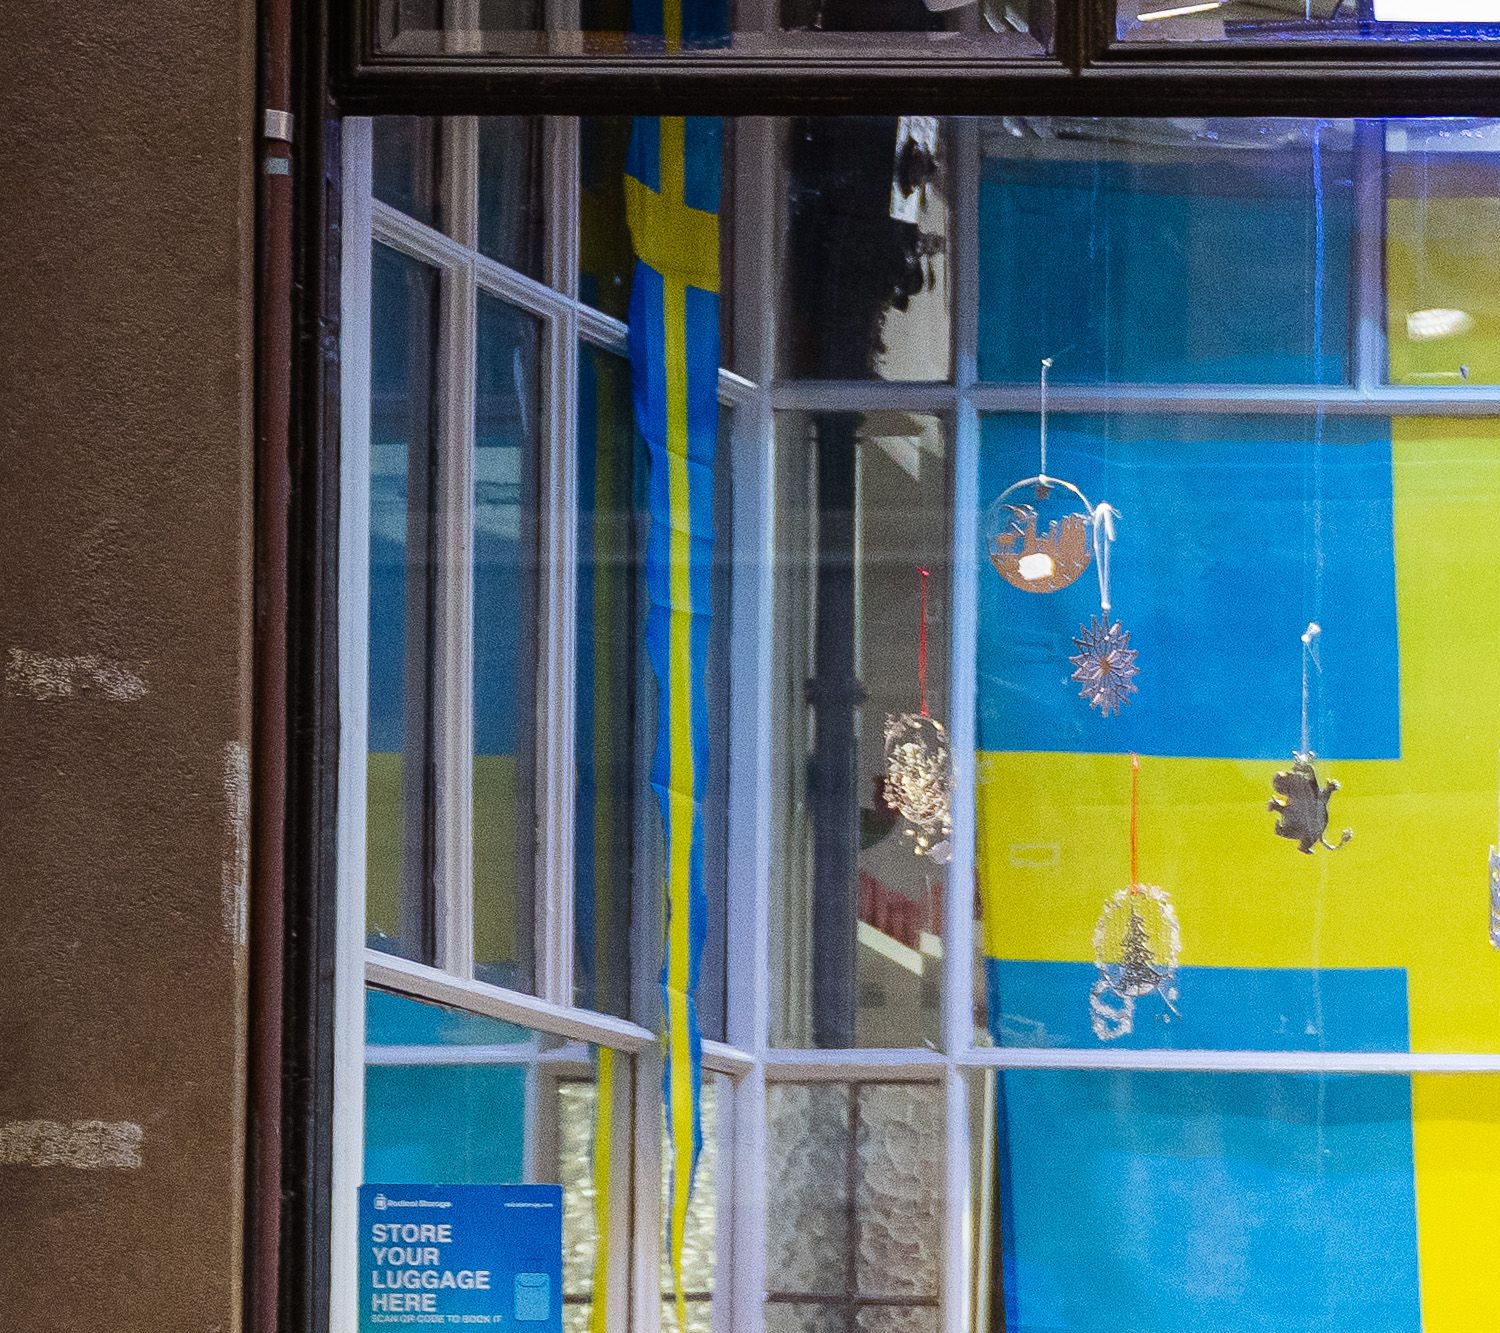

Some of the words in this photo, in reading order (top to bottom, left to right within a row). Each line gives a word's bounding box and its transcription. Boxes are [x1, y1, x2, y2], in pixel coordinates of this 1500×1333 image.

[372, 1223, 452, 1243] STORE
[372, 1247, 440, 1266] YOUR
[372, 1270, 491, 1290] LUGGAGE
[371, 1293, 437, 1312] HERE
[416, 1315, 445, 1324] CODE
[448, 1315, 460, 1324] TO
[463, 1315, 491, 1324] BOOK
